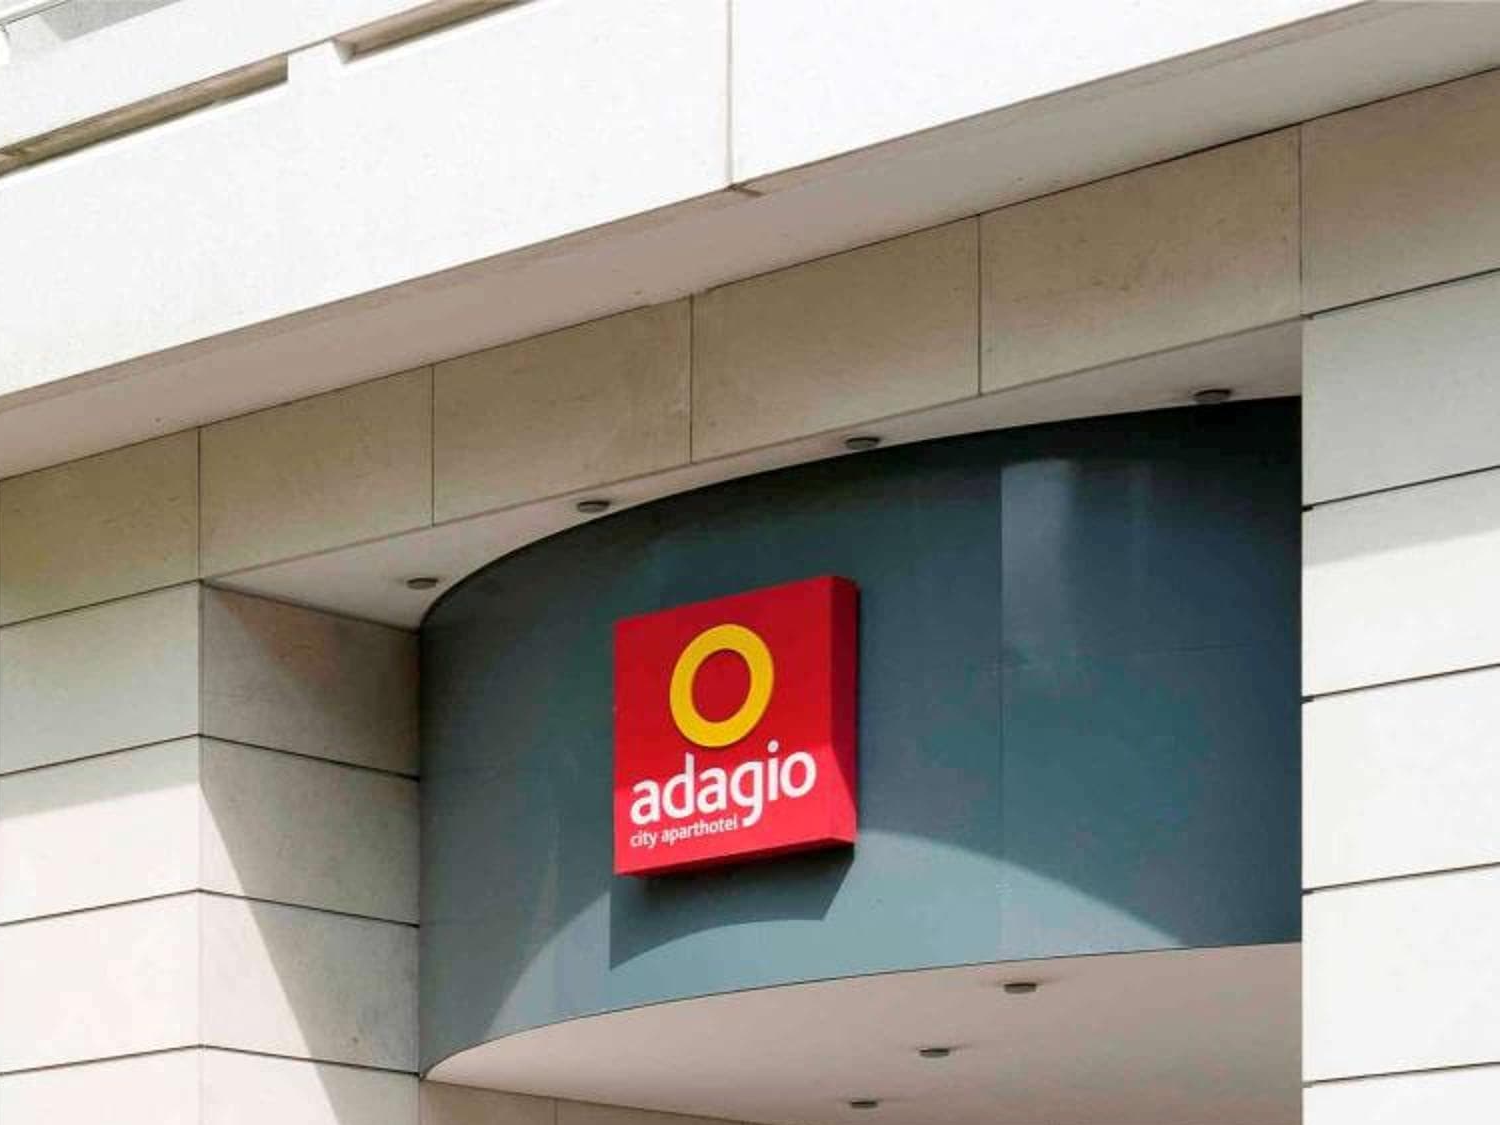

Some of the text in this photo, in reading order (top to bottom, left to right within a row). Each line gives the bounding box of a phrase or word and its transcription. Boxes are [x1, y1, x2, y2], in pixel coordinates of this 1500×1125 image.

[630, 740, 817, 827] adagio
[630, 814, 738, 849] city aparthotel
